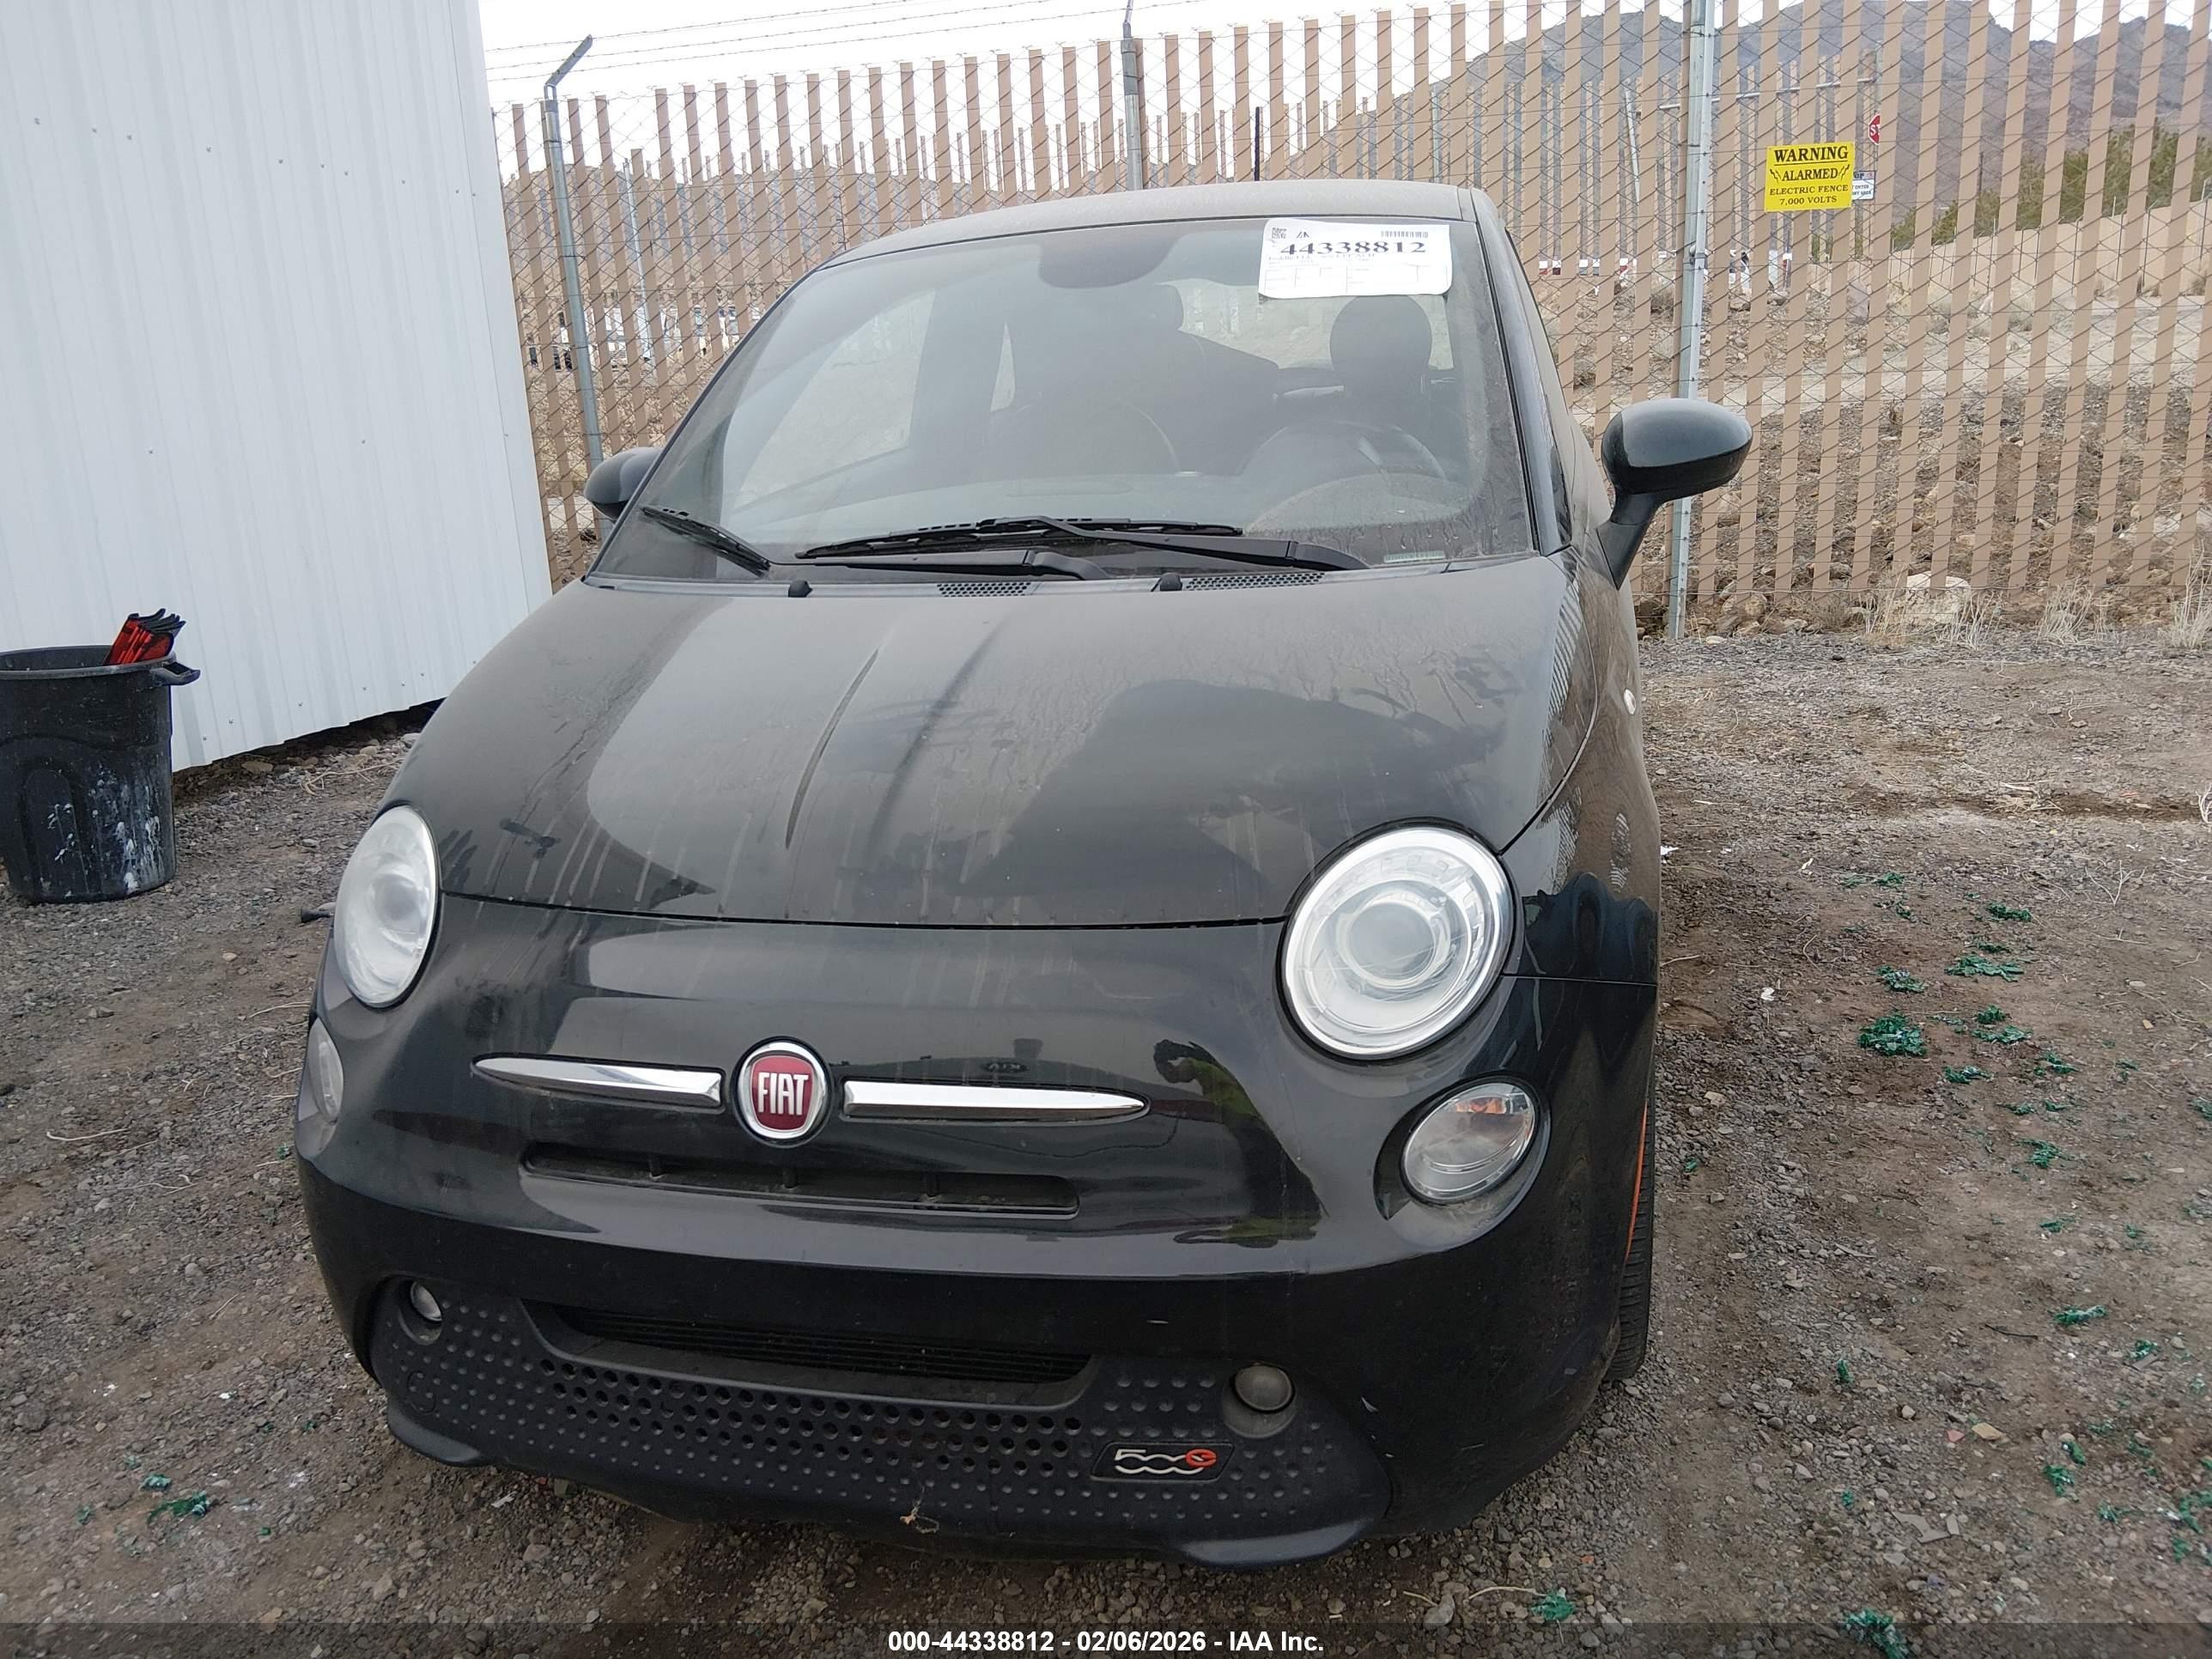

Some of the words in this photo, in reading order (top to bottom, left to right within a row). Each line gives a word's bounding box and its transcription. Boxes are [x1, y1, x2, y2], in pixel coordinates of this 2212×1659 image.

[1774, 146, 1848, 162] WARNING
[1782, 167, 1838, 181] ALARMED
[1770, 185, 1815, 196] ELECTRIC
[1818, 184, 1849, 193] FENCE
[1779, 197, 1805, 206] 7,000
[1808, 195, 1837, 204] VOLTS
[1280, 241, 1426, 255] 44338812
[757, 1072, 809, 1116] FIAT
